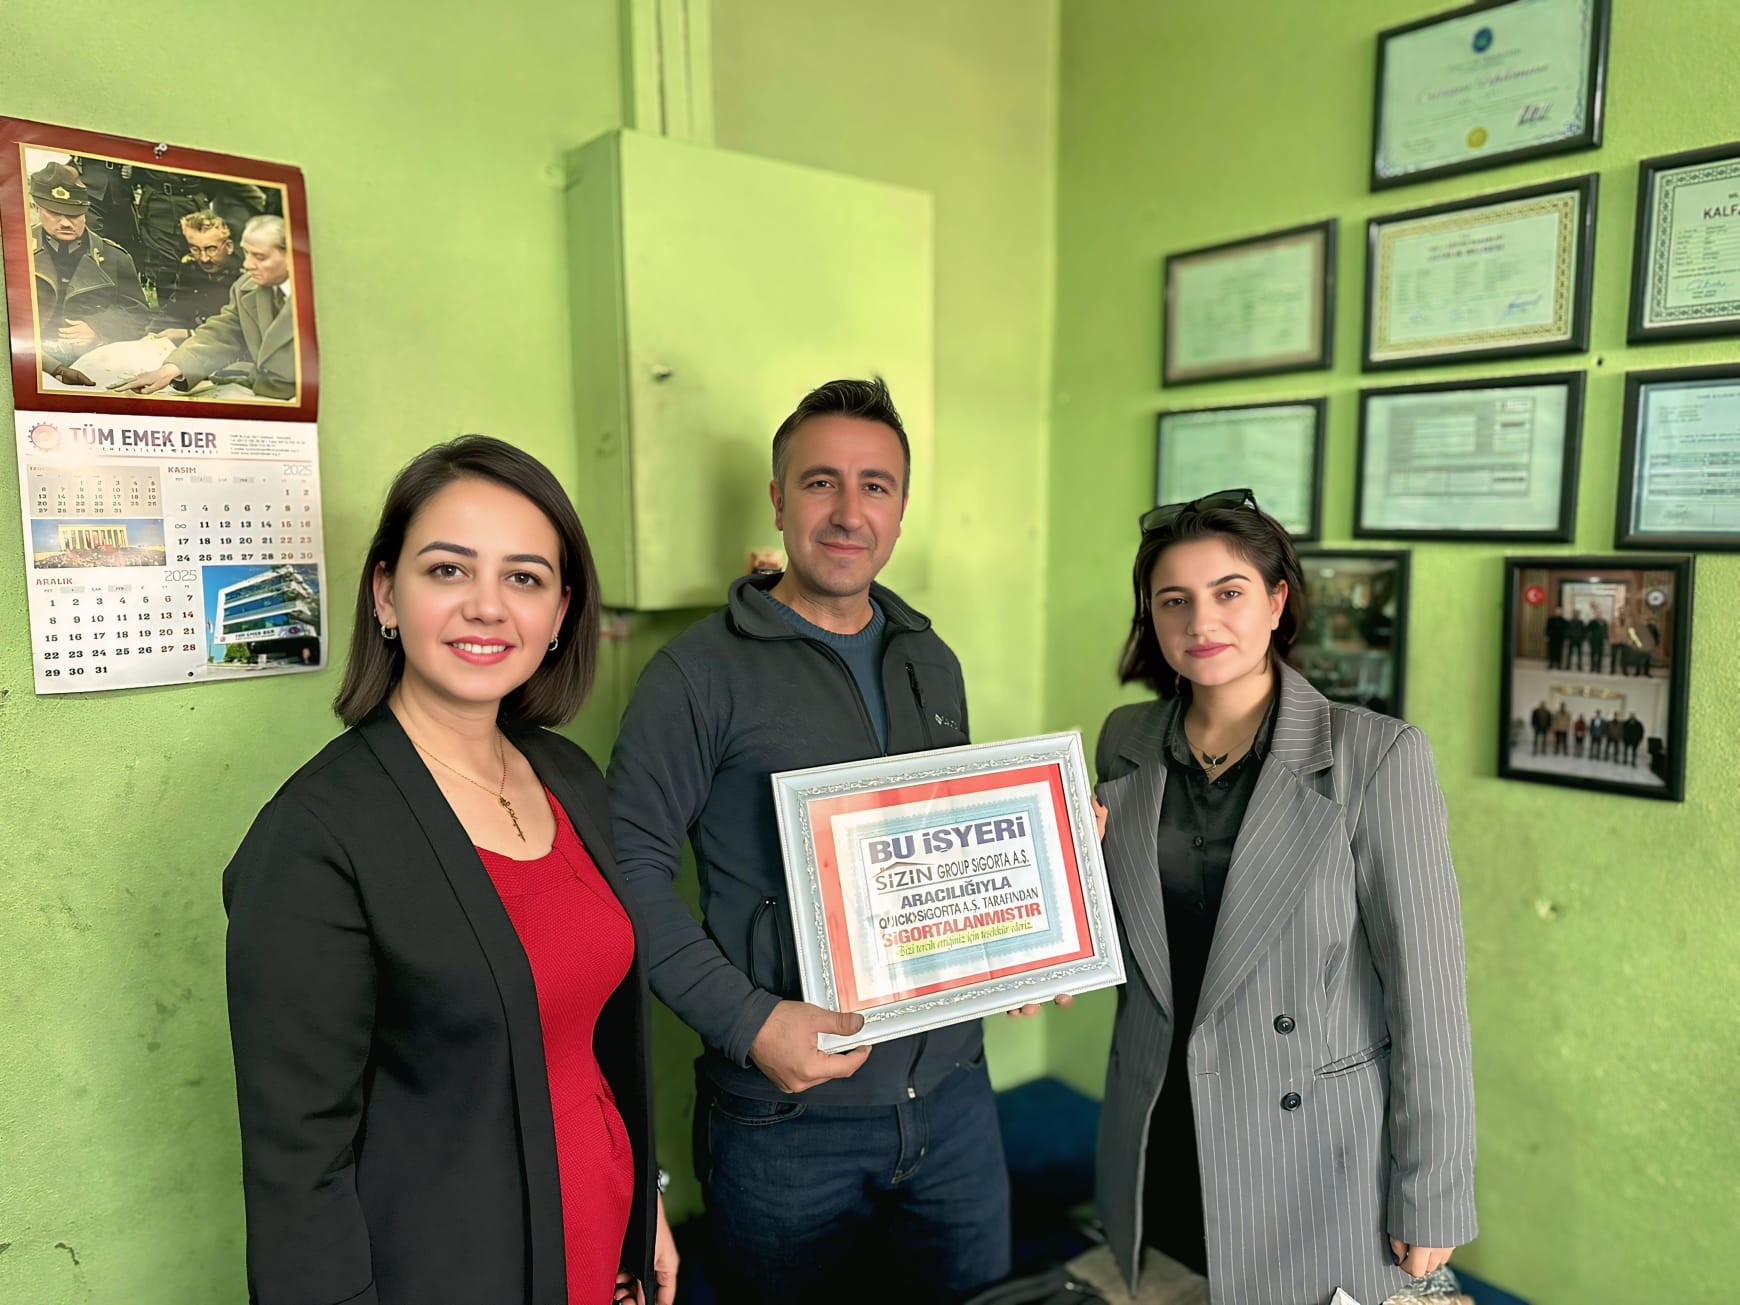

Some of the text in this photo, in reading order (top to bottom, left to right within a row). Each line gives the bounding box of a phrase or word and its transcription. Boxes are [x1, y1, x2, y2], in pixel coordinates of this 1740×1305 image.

[1704, 204, 1740, 220] KALF
[69, 424, 114, 446] TÜM
[121, 429, 175, 448] EMEK
[181, 431, 217, 449] DER
[168, 464, 313, 476] KASIM 2025
[164, 570, 197, 582] 2025
[868, 836, 915, 864] BU
[937, 860, 969, 879] GROUP
[901, 876, 1012, 909] ARACILIĞIYLA
[983, 887, 1039, 909] TARAFINDAN
